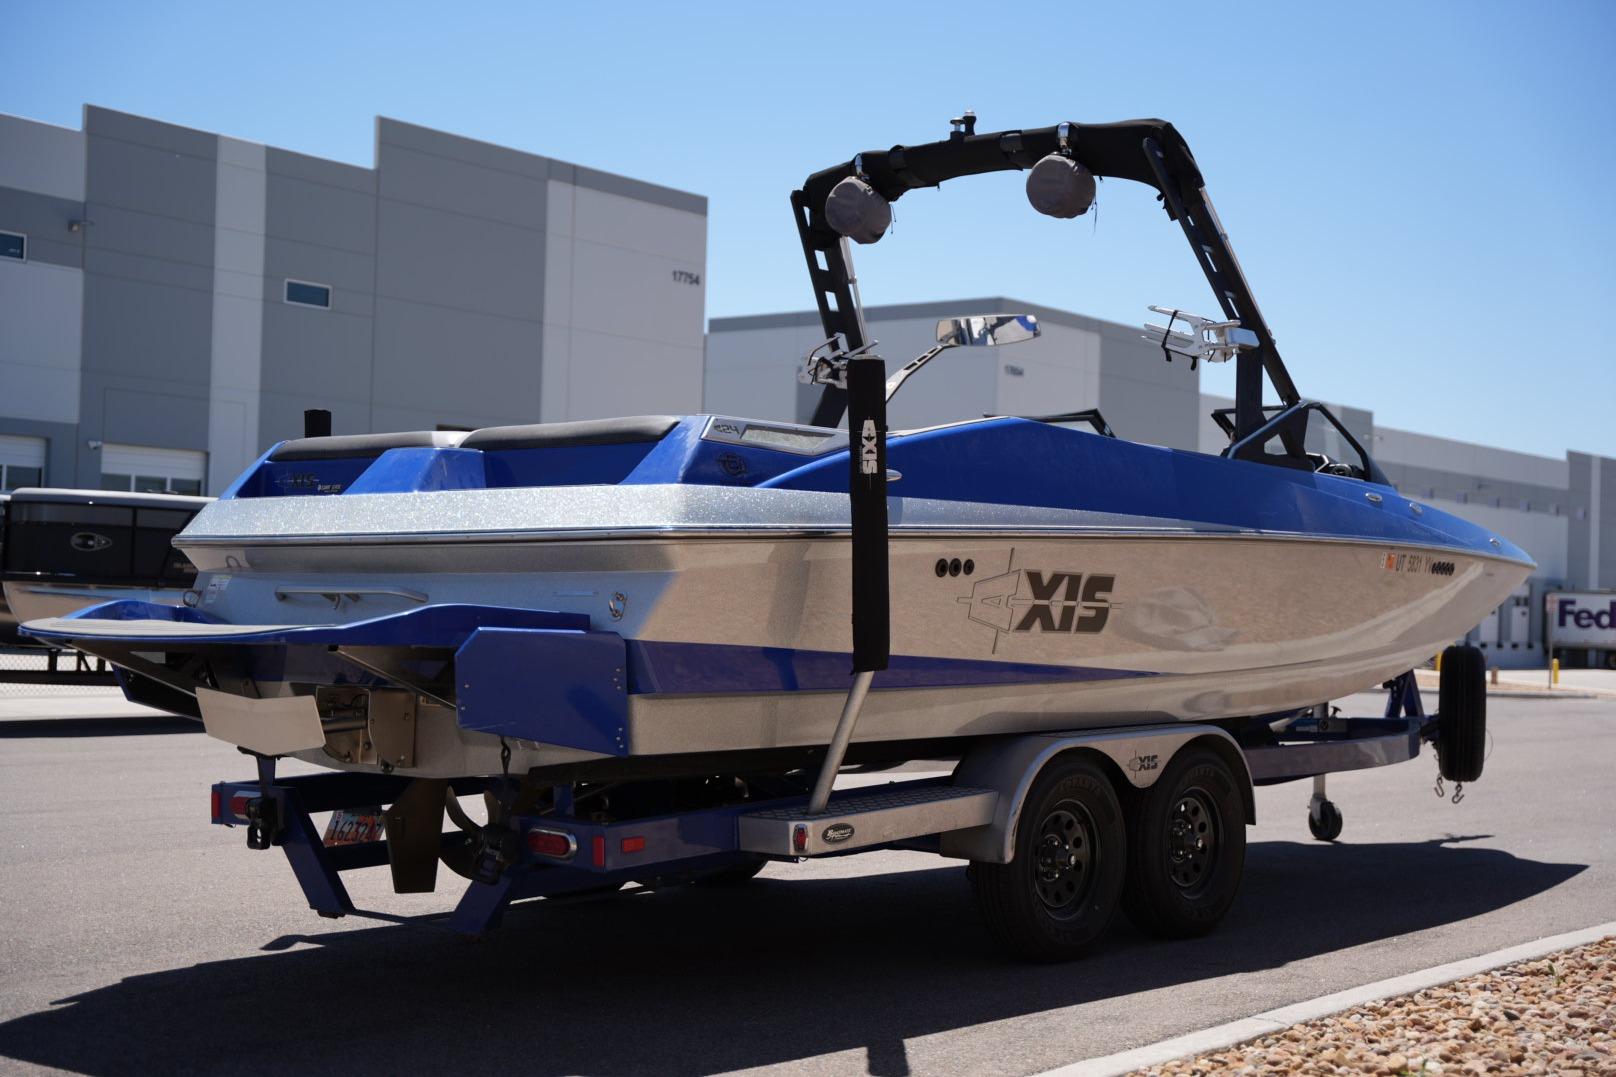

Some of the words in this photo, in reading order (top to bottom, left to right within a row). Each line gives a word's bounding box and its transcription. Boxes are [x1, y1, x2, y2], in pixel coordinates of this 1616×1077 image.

[672, 269, 700, 286] 17754
[862, 419, 878, 474] AXIS
[1558, 599, 1616, 628] Fed
